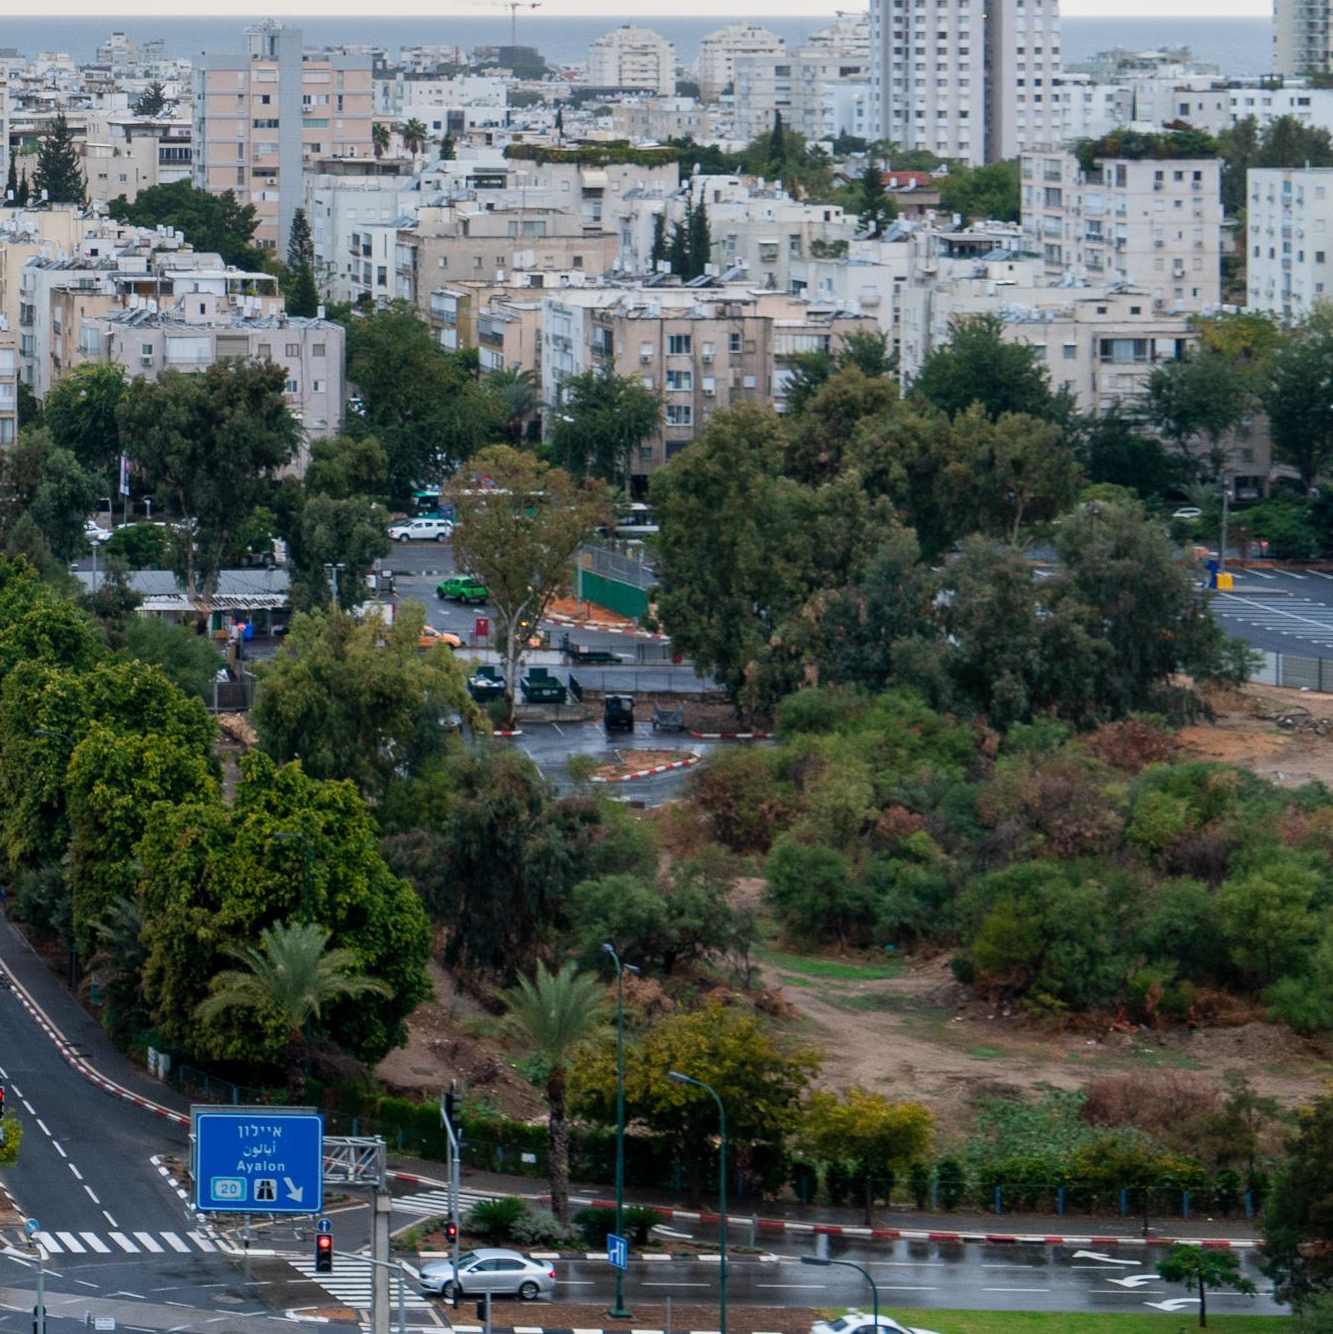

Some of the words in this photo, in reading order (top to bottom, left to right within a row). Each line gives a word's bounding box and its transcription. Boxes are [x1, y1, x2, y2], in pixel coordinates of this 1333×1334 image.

[238, 1124, 282, 1139] איילון
[243, 1140, 276, 1158] أيالون
[236, 1160, 285, 1174] Ayalon
[221, 1184, 237, 1194] 20
